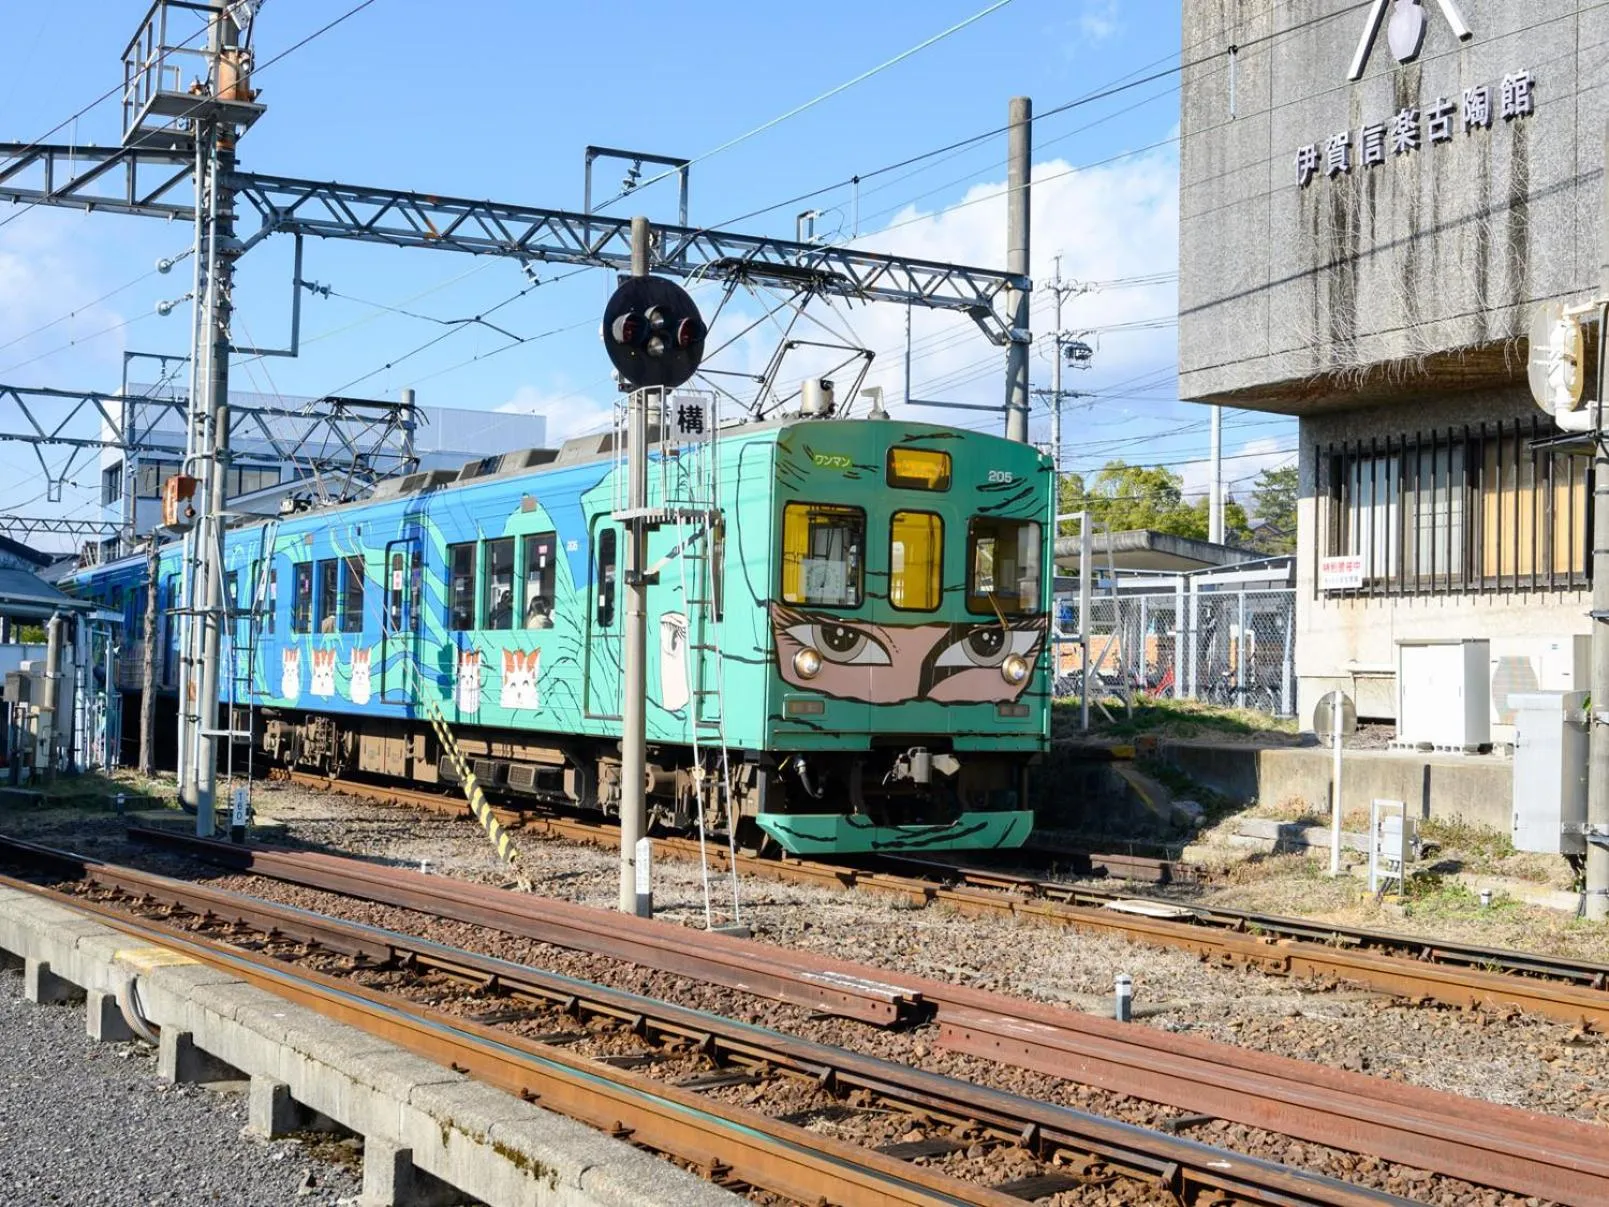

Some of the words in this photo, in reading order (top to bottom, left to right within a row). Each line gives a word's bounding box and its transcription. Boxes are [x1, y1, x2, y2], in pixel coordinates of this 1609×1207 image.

[1294, 68, 1534, 187] 伊賀信楽古陶館
[677, 404, 704, 434] 構
[815, 454, 850, 467] ワンマン
[988, 470, 1013, 483] 205
